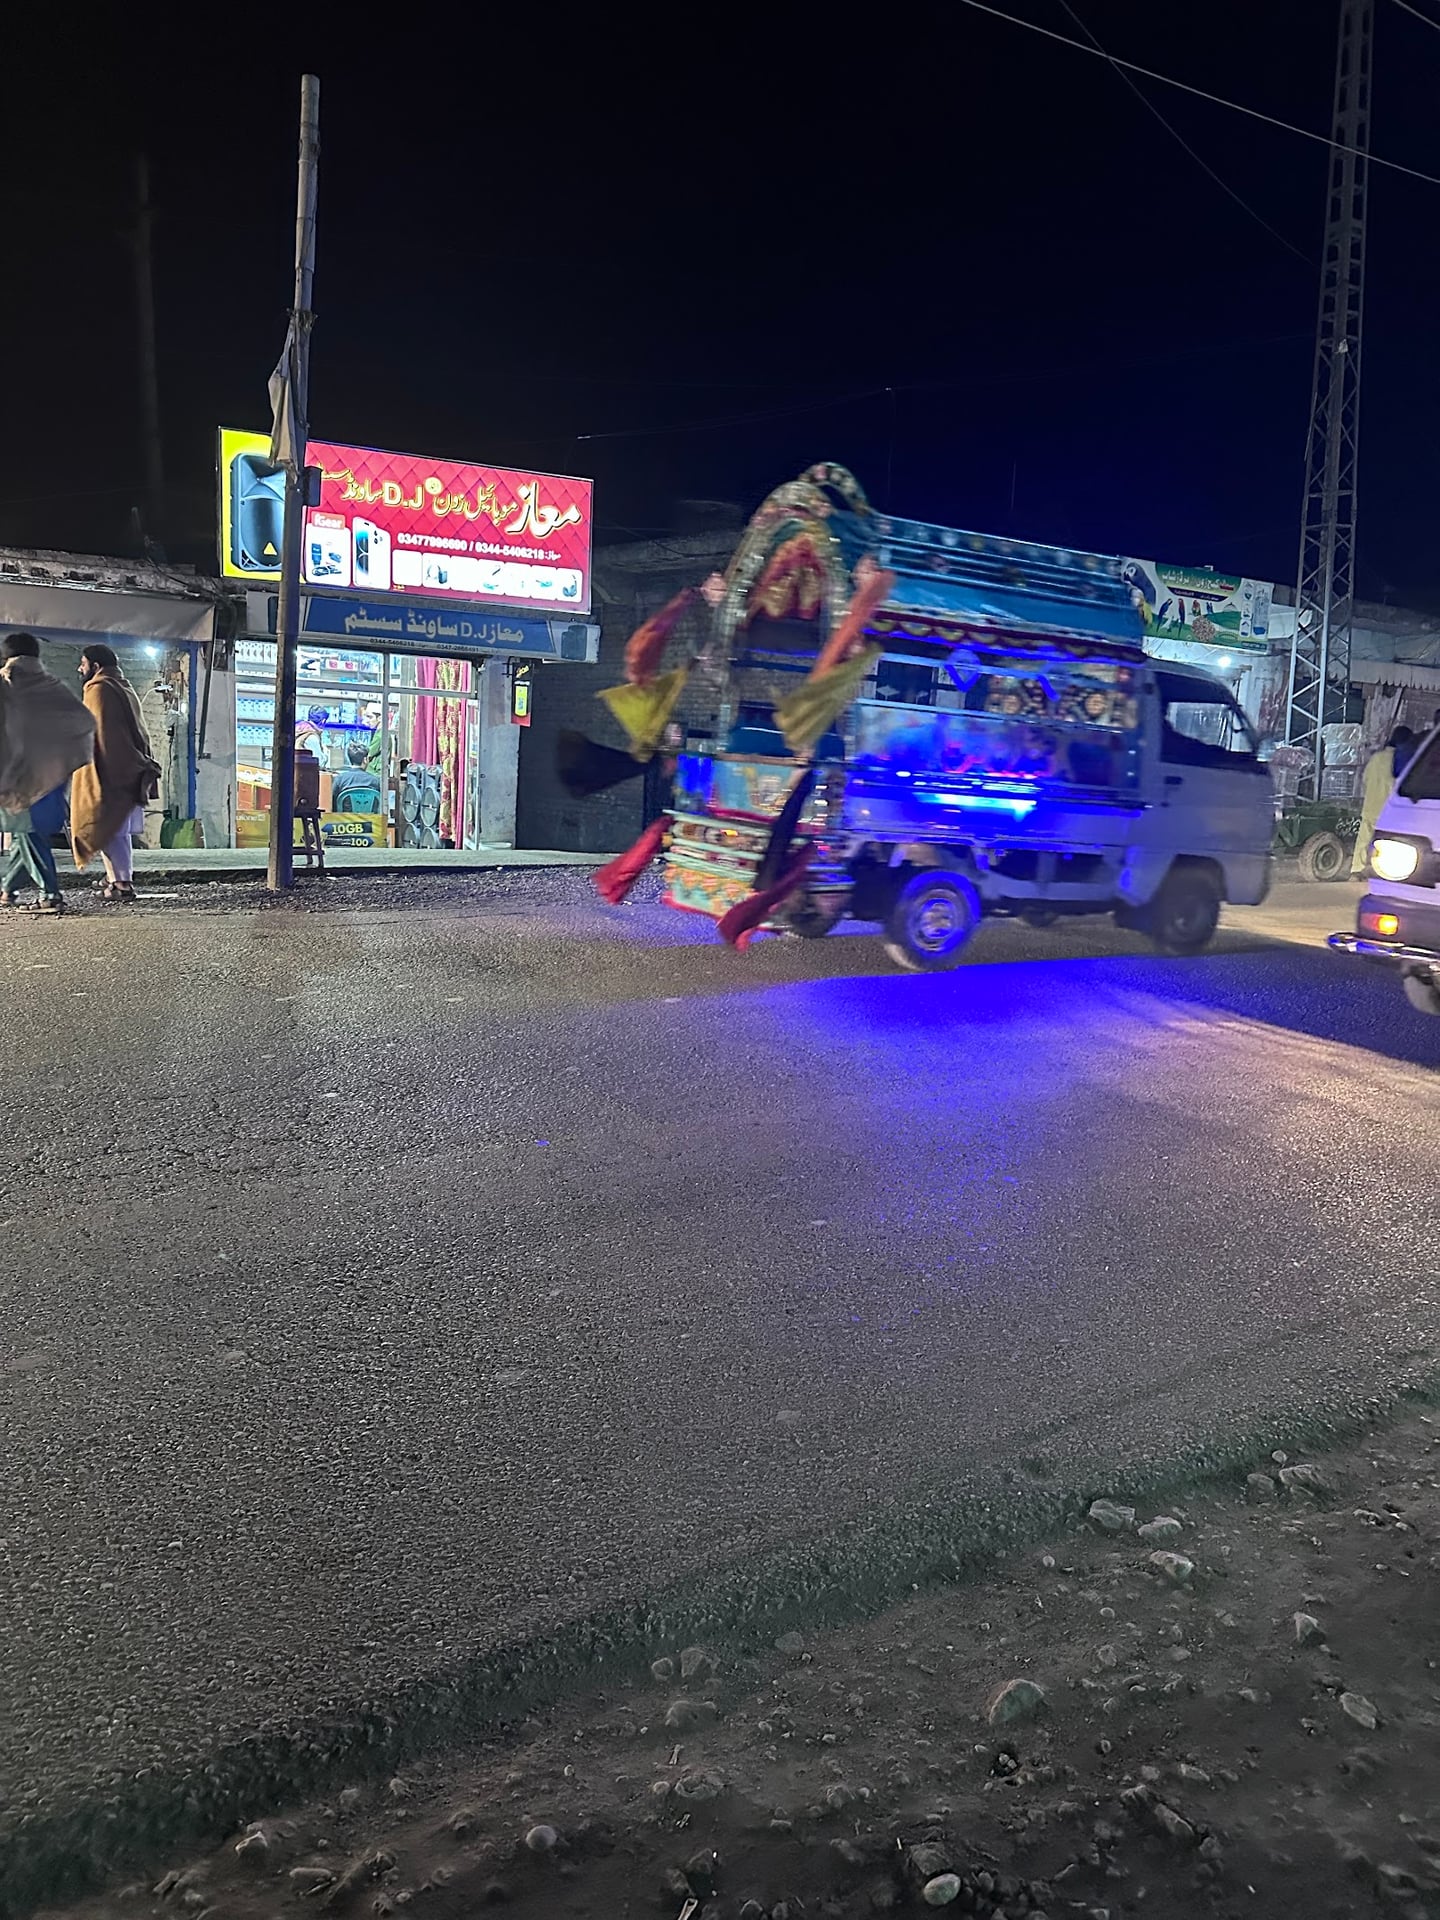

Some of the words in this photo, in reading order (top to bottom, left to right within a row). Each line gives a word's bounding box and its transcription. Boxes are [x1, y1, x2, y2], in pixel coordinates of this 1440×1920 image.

[384, 481, 423, 509] D.J
[433, 491, 466, 516] زون
[506, 480, 581, 538] معاز
[345, 607, 402, 634] سسٹم
[461, 623, 487, 639] D.J
[486, 623, 525, 644] معاز
[331, 823, 364, 835] 10GB
[350, 837, 369, 847] 100
